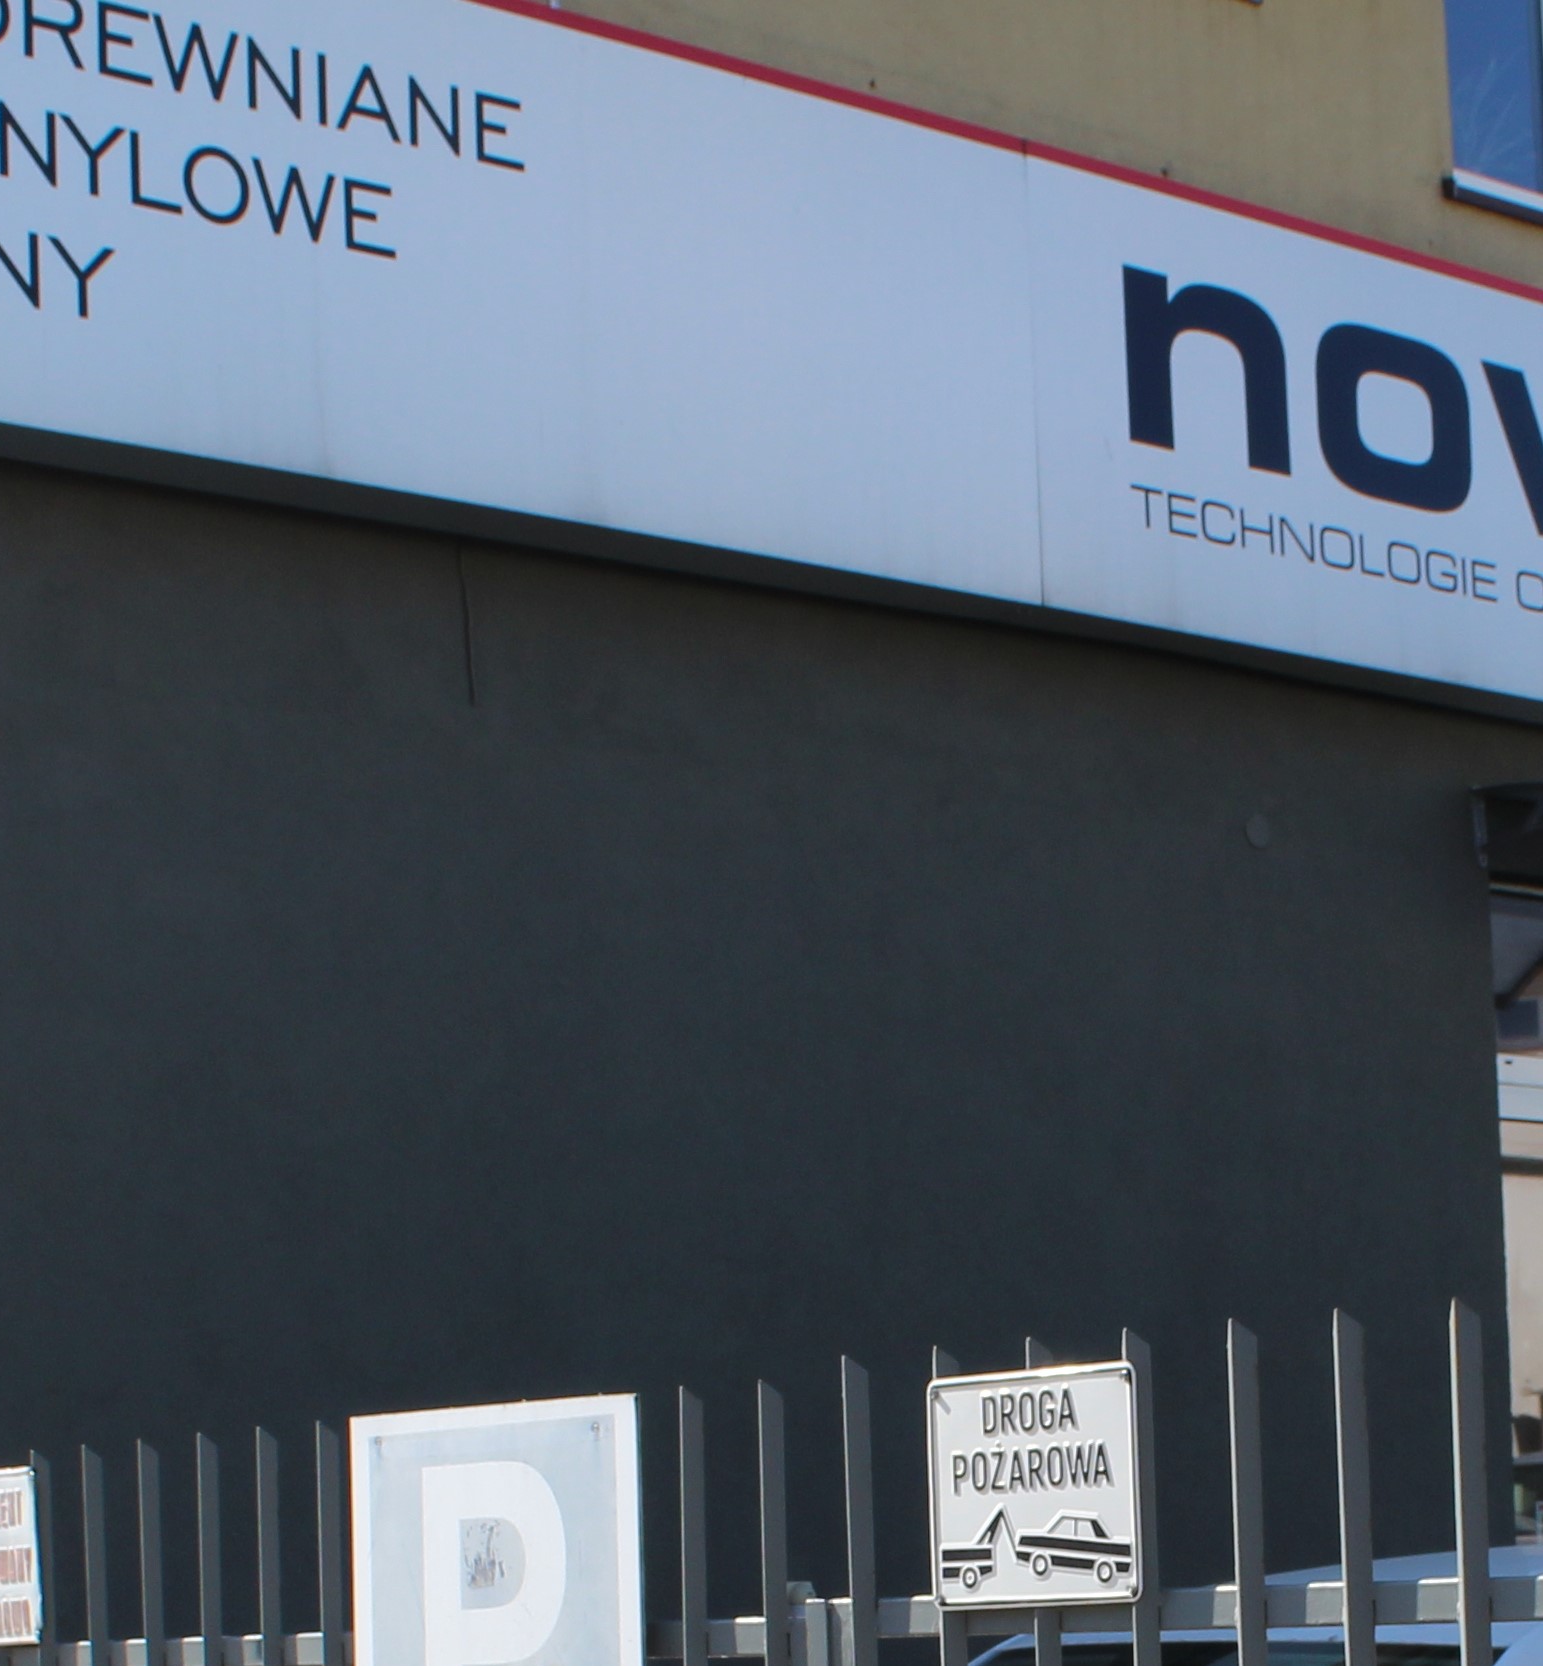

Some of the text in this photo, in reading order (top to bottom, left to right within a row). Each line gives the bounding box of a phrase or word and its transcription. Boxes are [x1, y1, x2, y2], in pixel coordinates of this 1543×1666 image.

[1130, 484, 1499, 603] TECHNOLOGIE
[981, 1384, 1077, 1436] DROGA
[952, 1440, 1113, 1495] POŻAROWA
